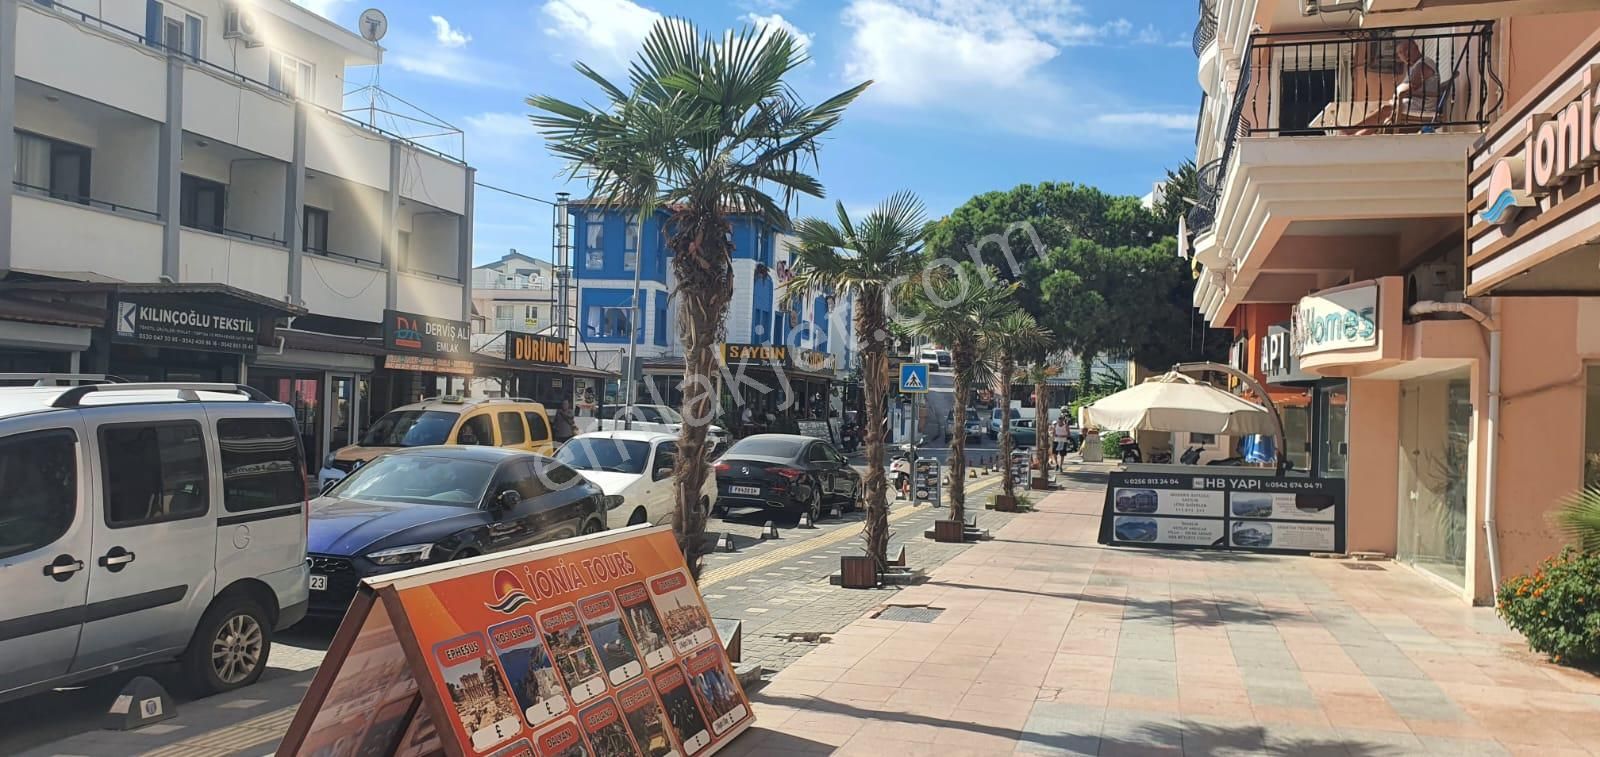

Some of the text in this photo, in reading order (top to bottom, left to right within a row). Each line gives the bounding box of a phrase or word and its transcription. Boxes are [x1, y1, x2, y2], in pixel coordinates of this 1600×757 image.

[140, 306, 210, 328] KILINÇOĞLU
[213, 316, 254, 333] TEKSTİL
[425, 321, 470, 339] DERVİŞ ALİ
[436, 342, 459, 353] EMLAK
[515, 335, 570, 364] DÜRÜMCÜ
[729, 345, 785, 360] SAYGIN
[1206, 478, 1226, 488] HB
[1230, 479, 1261, 489] YAPI
[311, 577, 324, 589] 23
[525, 551, 636, 600] İONİA TOURS
[495, 632, 509, 645] KOS
[445, 641, 480, 660] EPHESUS
[545, 728, 572, 749] DALYAN
